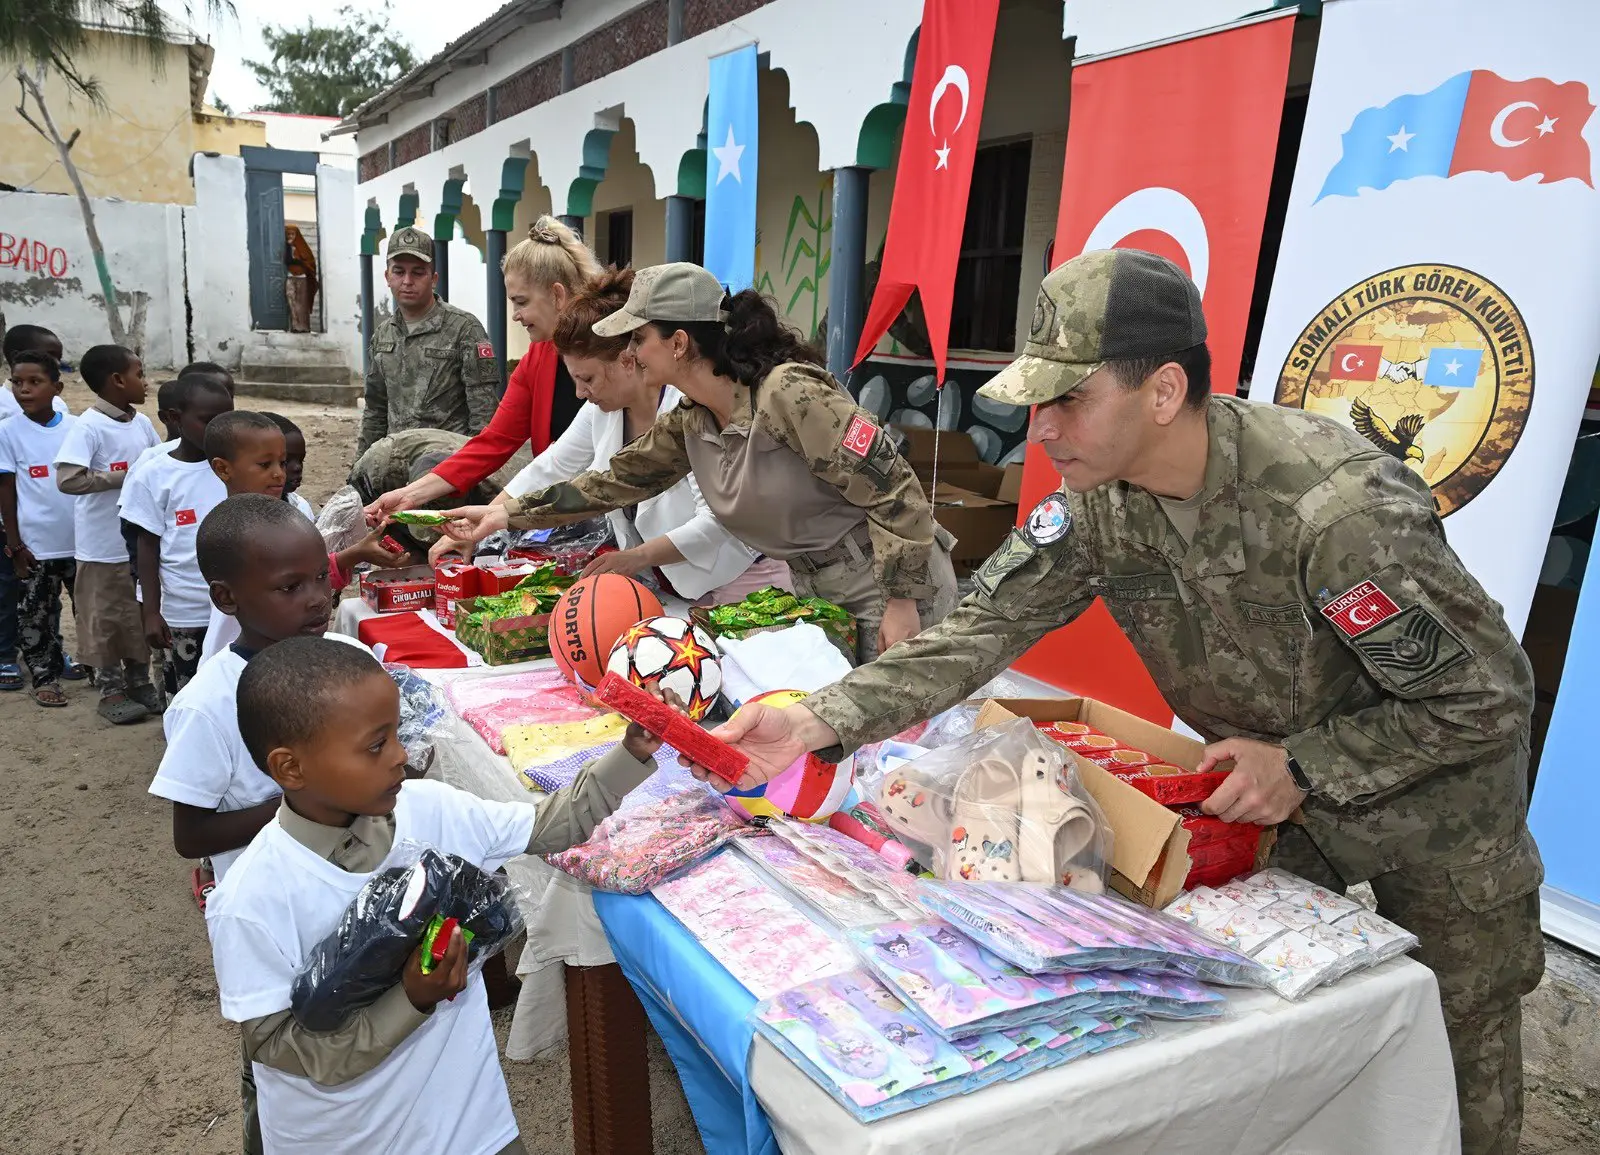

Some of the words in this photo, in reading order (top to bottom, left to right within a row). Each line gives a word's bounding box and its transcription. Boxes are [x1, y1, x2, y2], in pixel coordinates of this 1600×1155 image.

[1292, 298, 1354, 371] SOMALİ
[1353, 274, 1407, 310] TÜRK
[1413, 269, 1481, 304] GÖREV
[1475, 295, 1529, 377] KUVVETİ
[565, 586, 587, 663] SPORTS
[1327, 584, 1372, 614] TÜRKİYE
